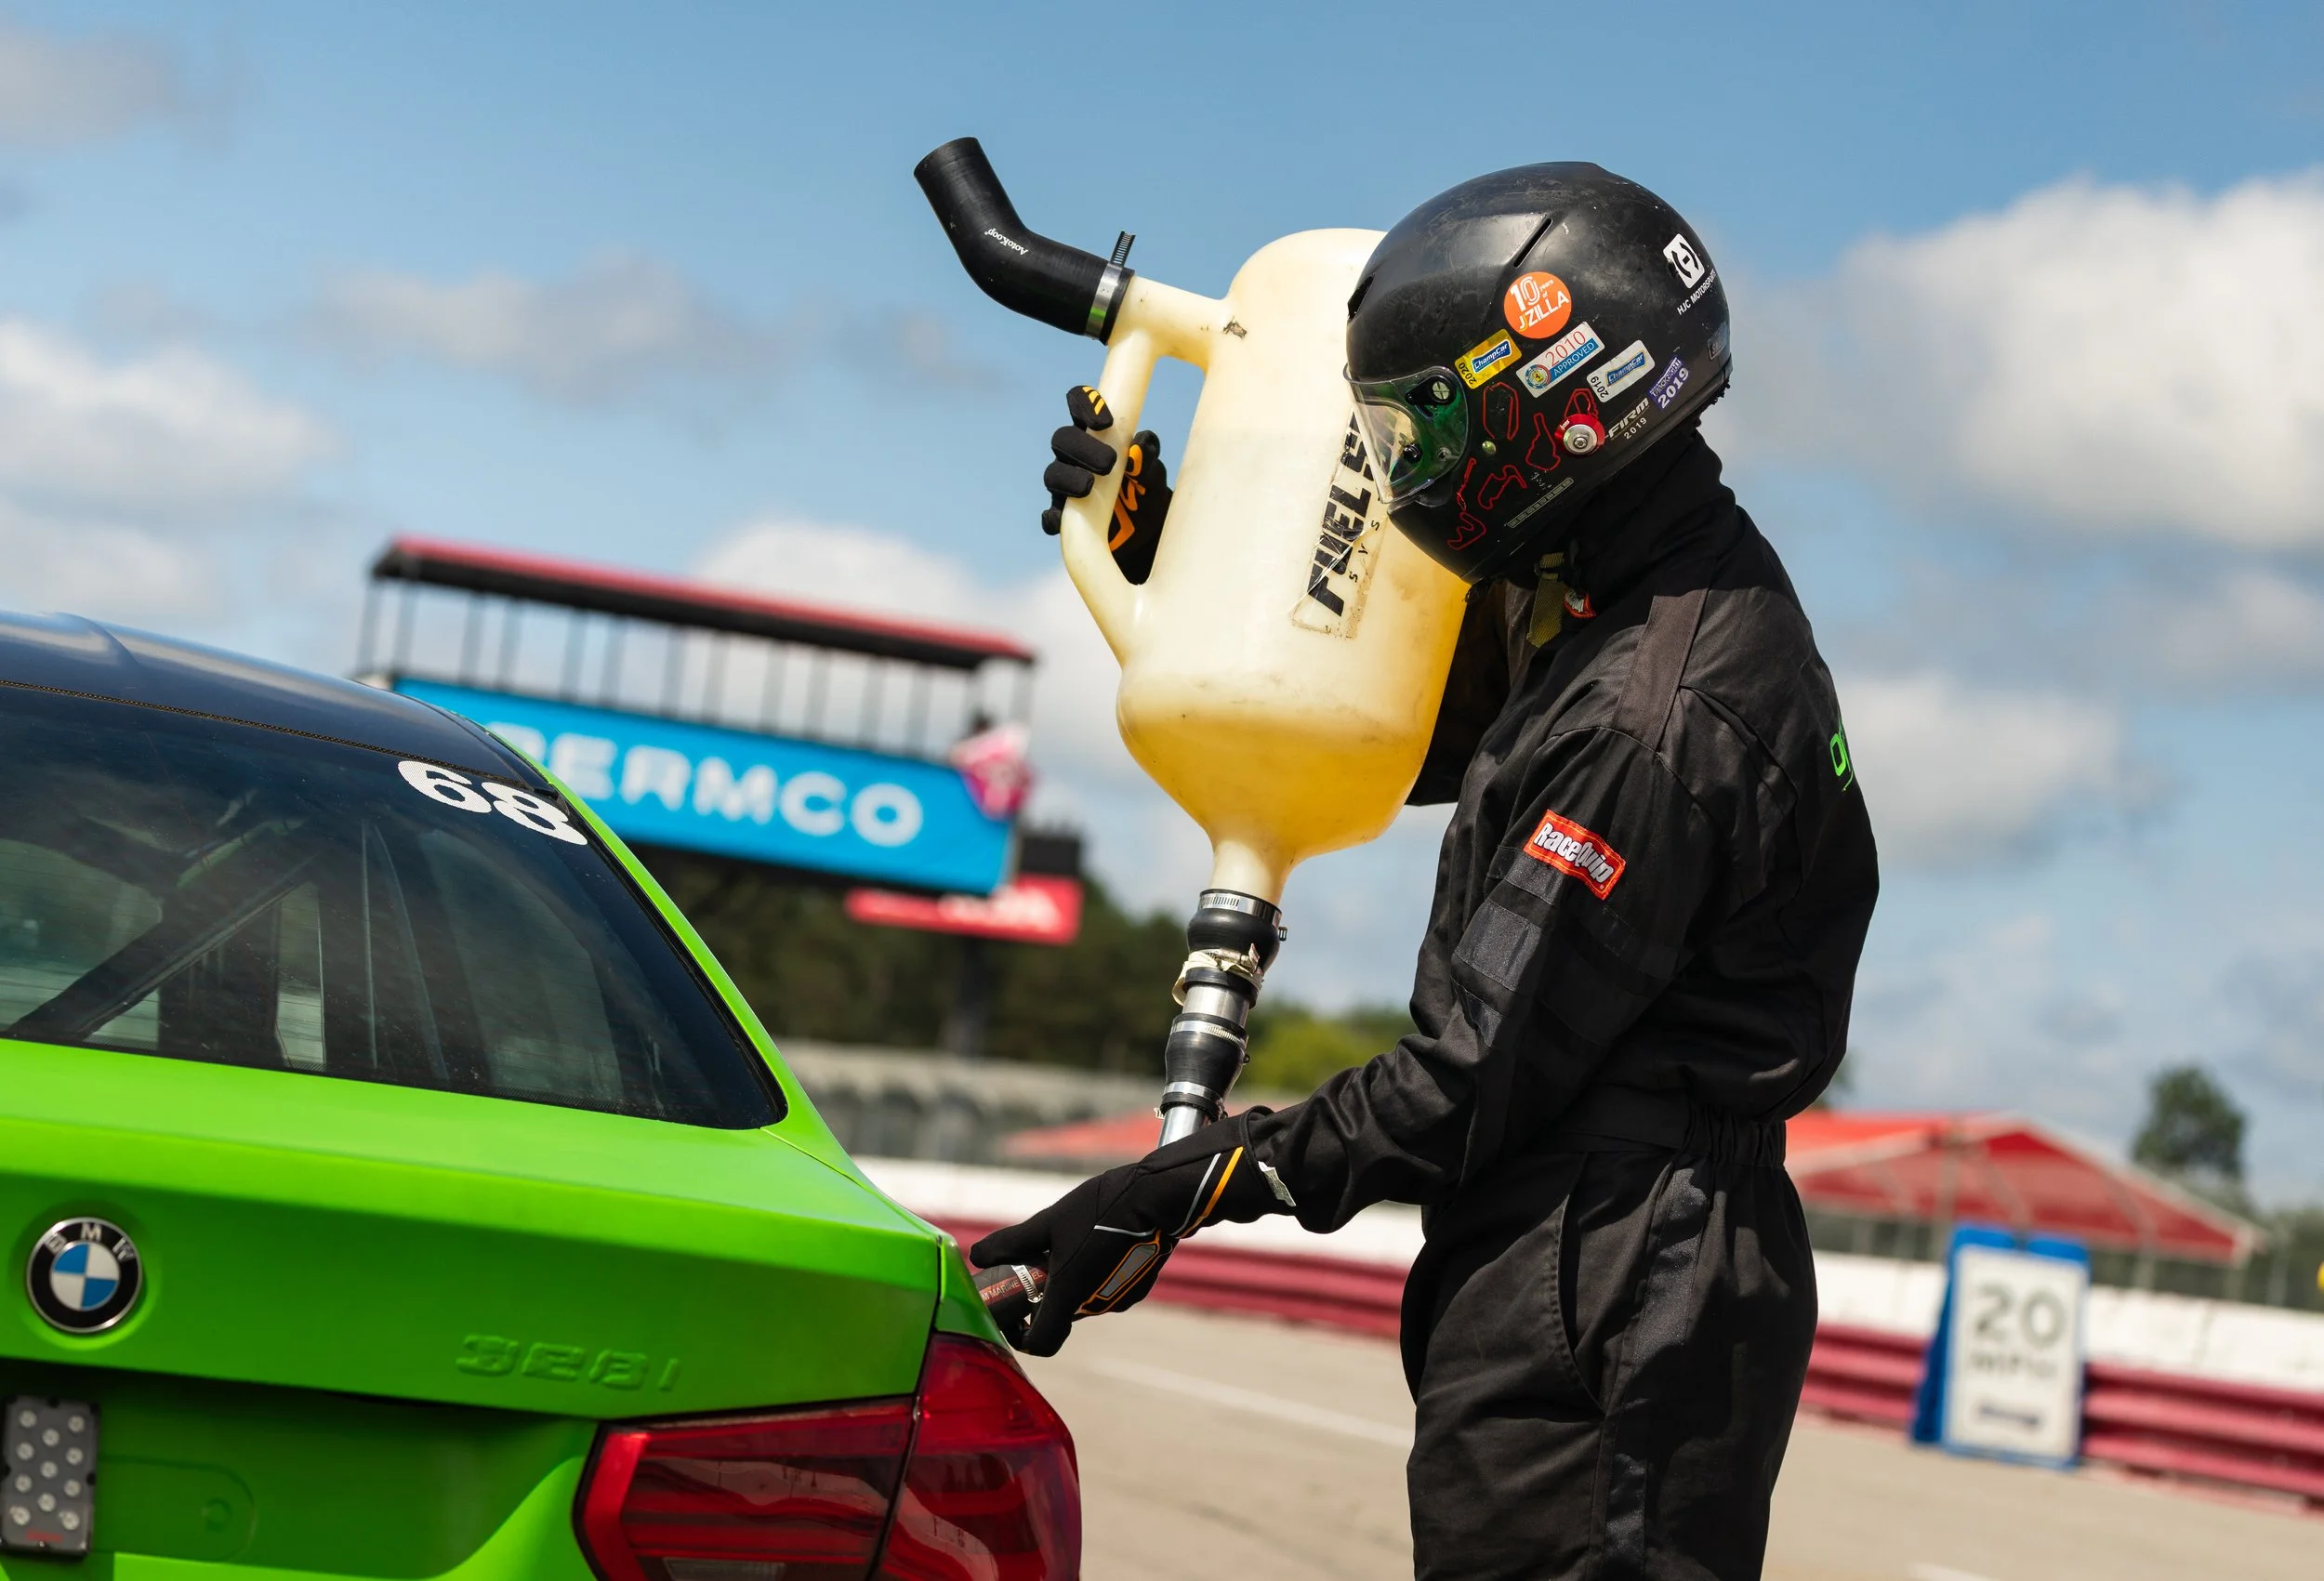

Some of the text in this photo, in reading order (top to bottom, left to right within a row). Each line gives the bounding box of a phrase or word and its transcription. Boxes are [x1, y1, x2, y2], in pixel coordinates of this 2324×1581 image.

[987, 228, 1029, 256] AotoKoop
[1510, 276, 1554, 312] 10 years
[1518, 290, 1570, 333] JZILLA
[1677, 299, 1692, 316] HJC
[1474, 343, 1508, 370] ChampCar
[1545, 331, 1586, 367] 2010
[1553, 342, 1595, 377] APPROVED
[1458, 362, 1477, 385] 2020
[1608, 353, 1644, 383] ChampCar
[1591, 375, 1609, 399] 2019
[1657, 367, 1689, 409] 2019
[1623, 417, 1647, 440] 2019
[1307, 484, 1372, 617] FUEL
[397, 758, 588, 846] 68
[1533, 822, 1615, 883] RaceQuip
[43, 1221, 136, 1261] BMW
[990, 1280, 1021, 1298] MARINE
[1972, 1281, 2067, 1350] 20
